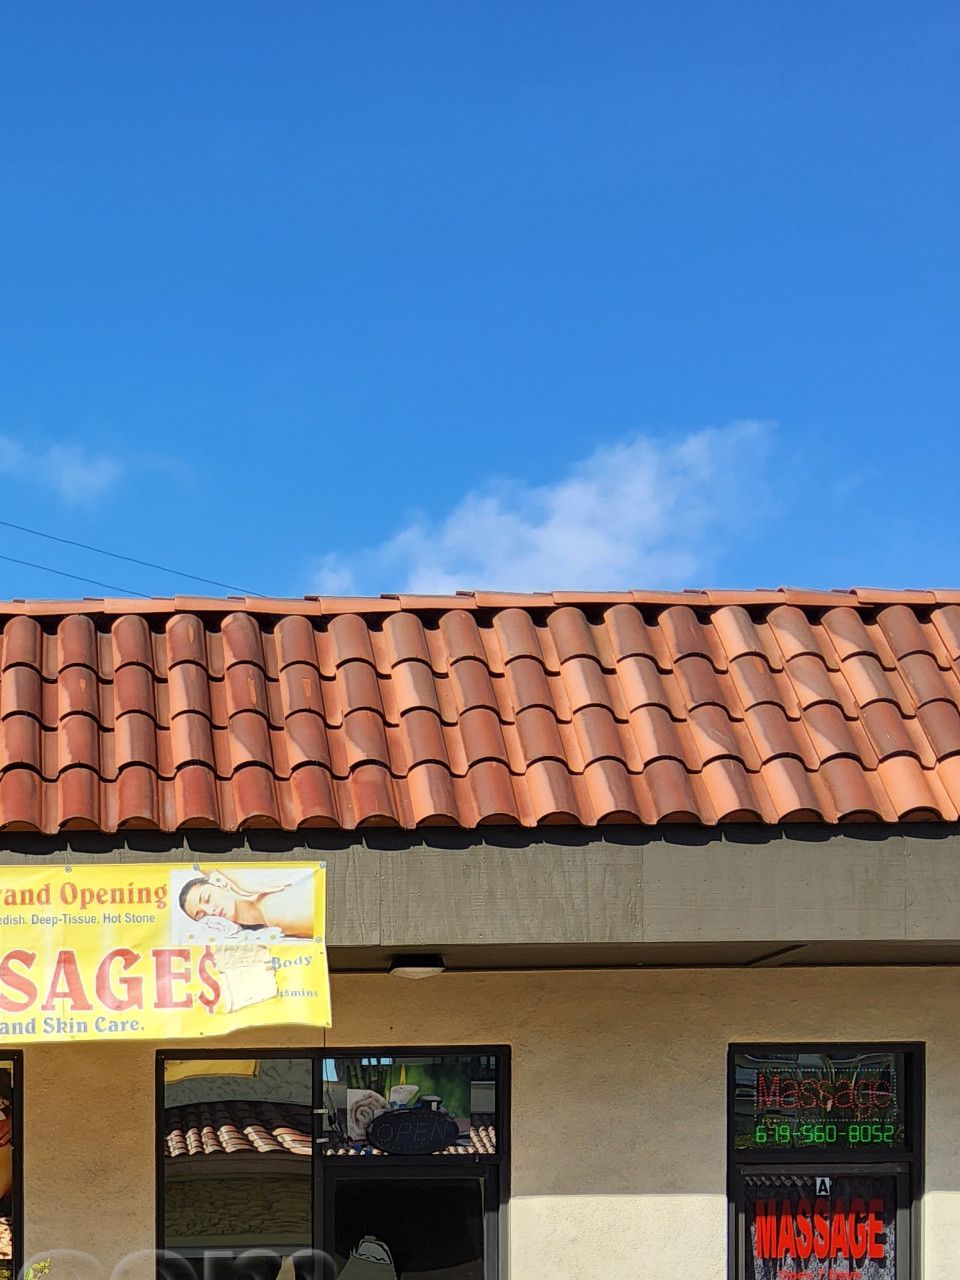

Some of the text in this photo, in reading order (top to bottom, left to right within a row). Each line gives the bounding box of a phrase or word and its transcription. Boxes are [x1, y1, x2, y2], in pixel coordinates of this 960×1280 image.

[60, 881, 168, 909] Opening
[103, 912, 121, 924] Hot
[125, 912, 156, 924] Stone
[43, 1016, 88, 1034] Skin
[95, 1015, 145, 1033] Care.
[757, 1072, 893, 1119] Massage
[818, 1178, 829, 1194] A
[755, 1199, 885, 1260] MASSAGE
